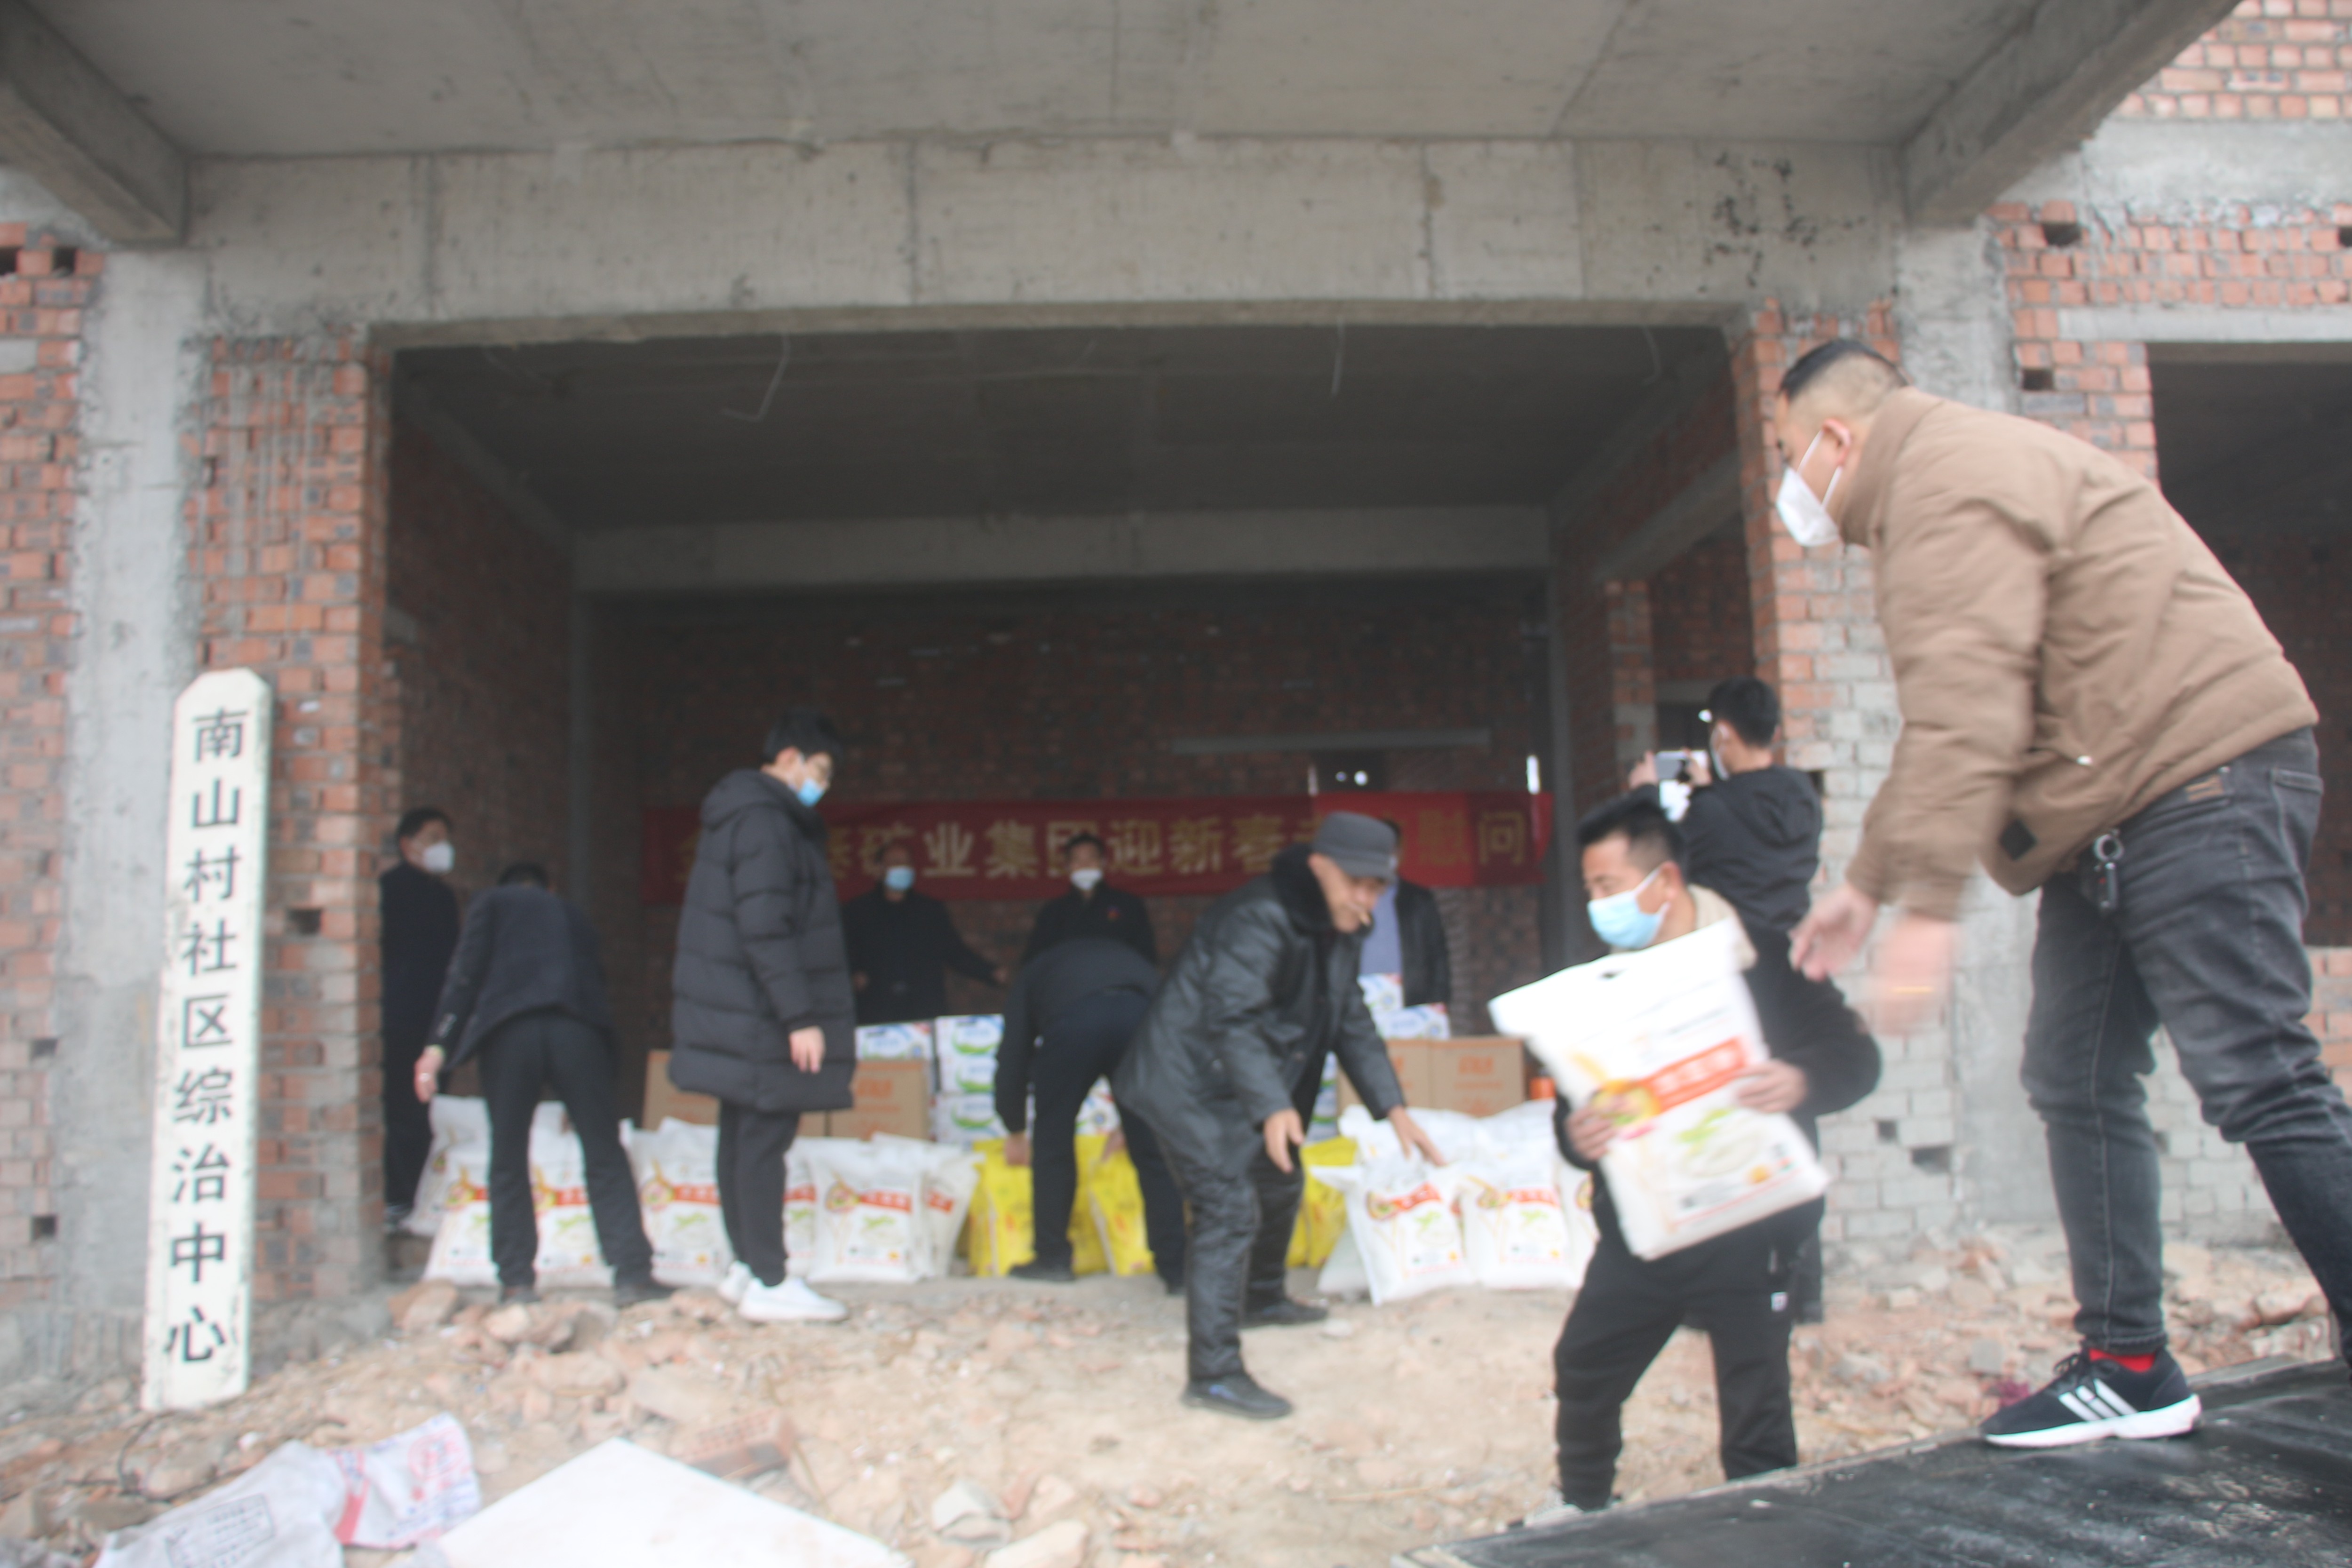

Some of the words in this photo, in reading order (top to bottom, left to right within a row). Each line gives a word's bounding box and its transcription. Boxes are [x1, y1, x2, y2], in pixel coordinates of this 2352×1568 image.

[164, 708, 249, 1362] 南山村社区综治中心
